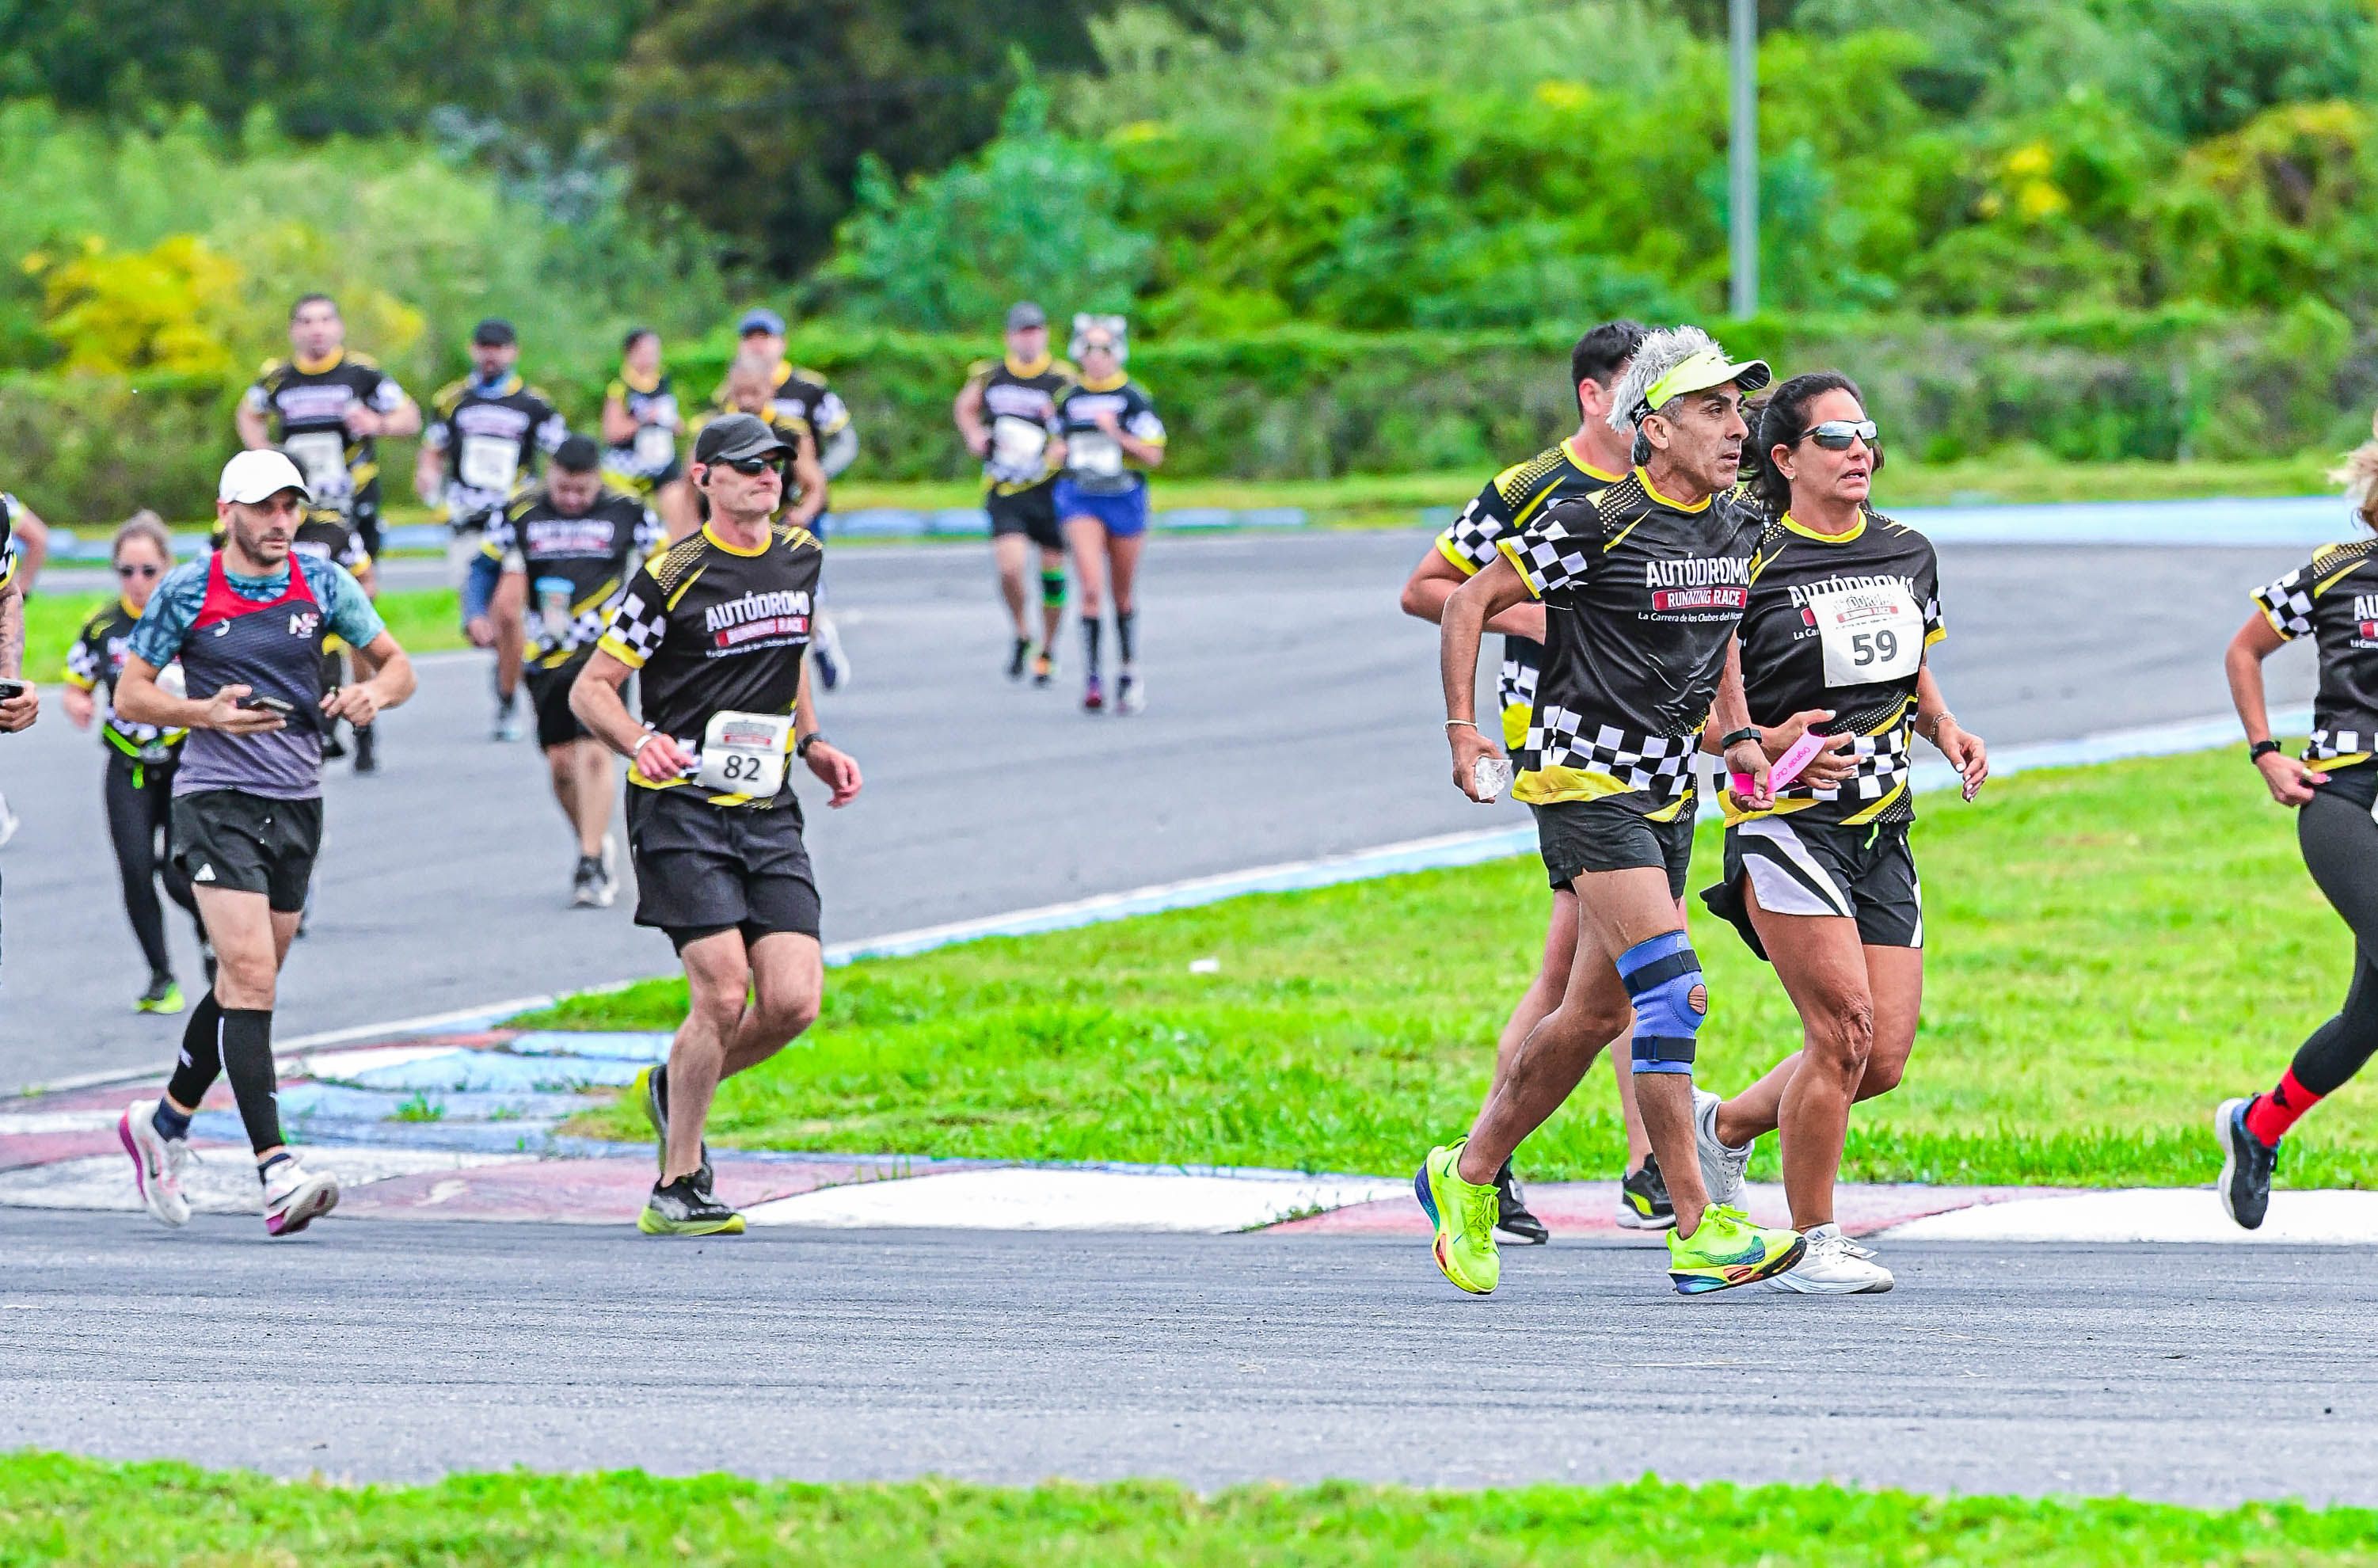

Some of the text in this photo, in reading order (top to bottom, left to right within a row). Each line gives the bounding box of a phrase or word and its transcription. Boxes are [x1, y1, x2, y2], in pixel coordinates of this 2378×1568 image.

[1668, 589, 1741, 608] RUNNING RACE
[1638, 611, 1649, 621] La
[1651, 612, 1679, 622] Carrera
[1680, 613, 1687, 622] de
[1688, 613, 1697, 622] los
[1698, 612, 1719, 622] Clubes
[1719, 611, 1729, 622] del
[1794, 631, 1805, 641] La
[1852, 630, 1897, 666] 59
[724, 755, 761, 781] 82
